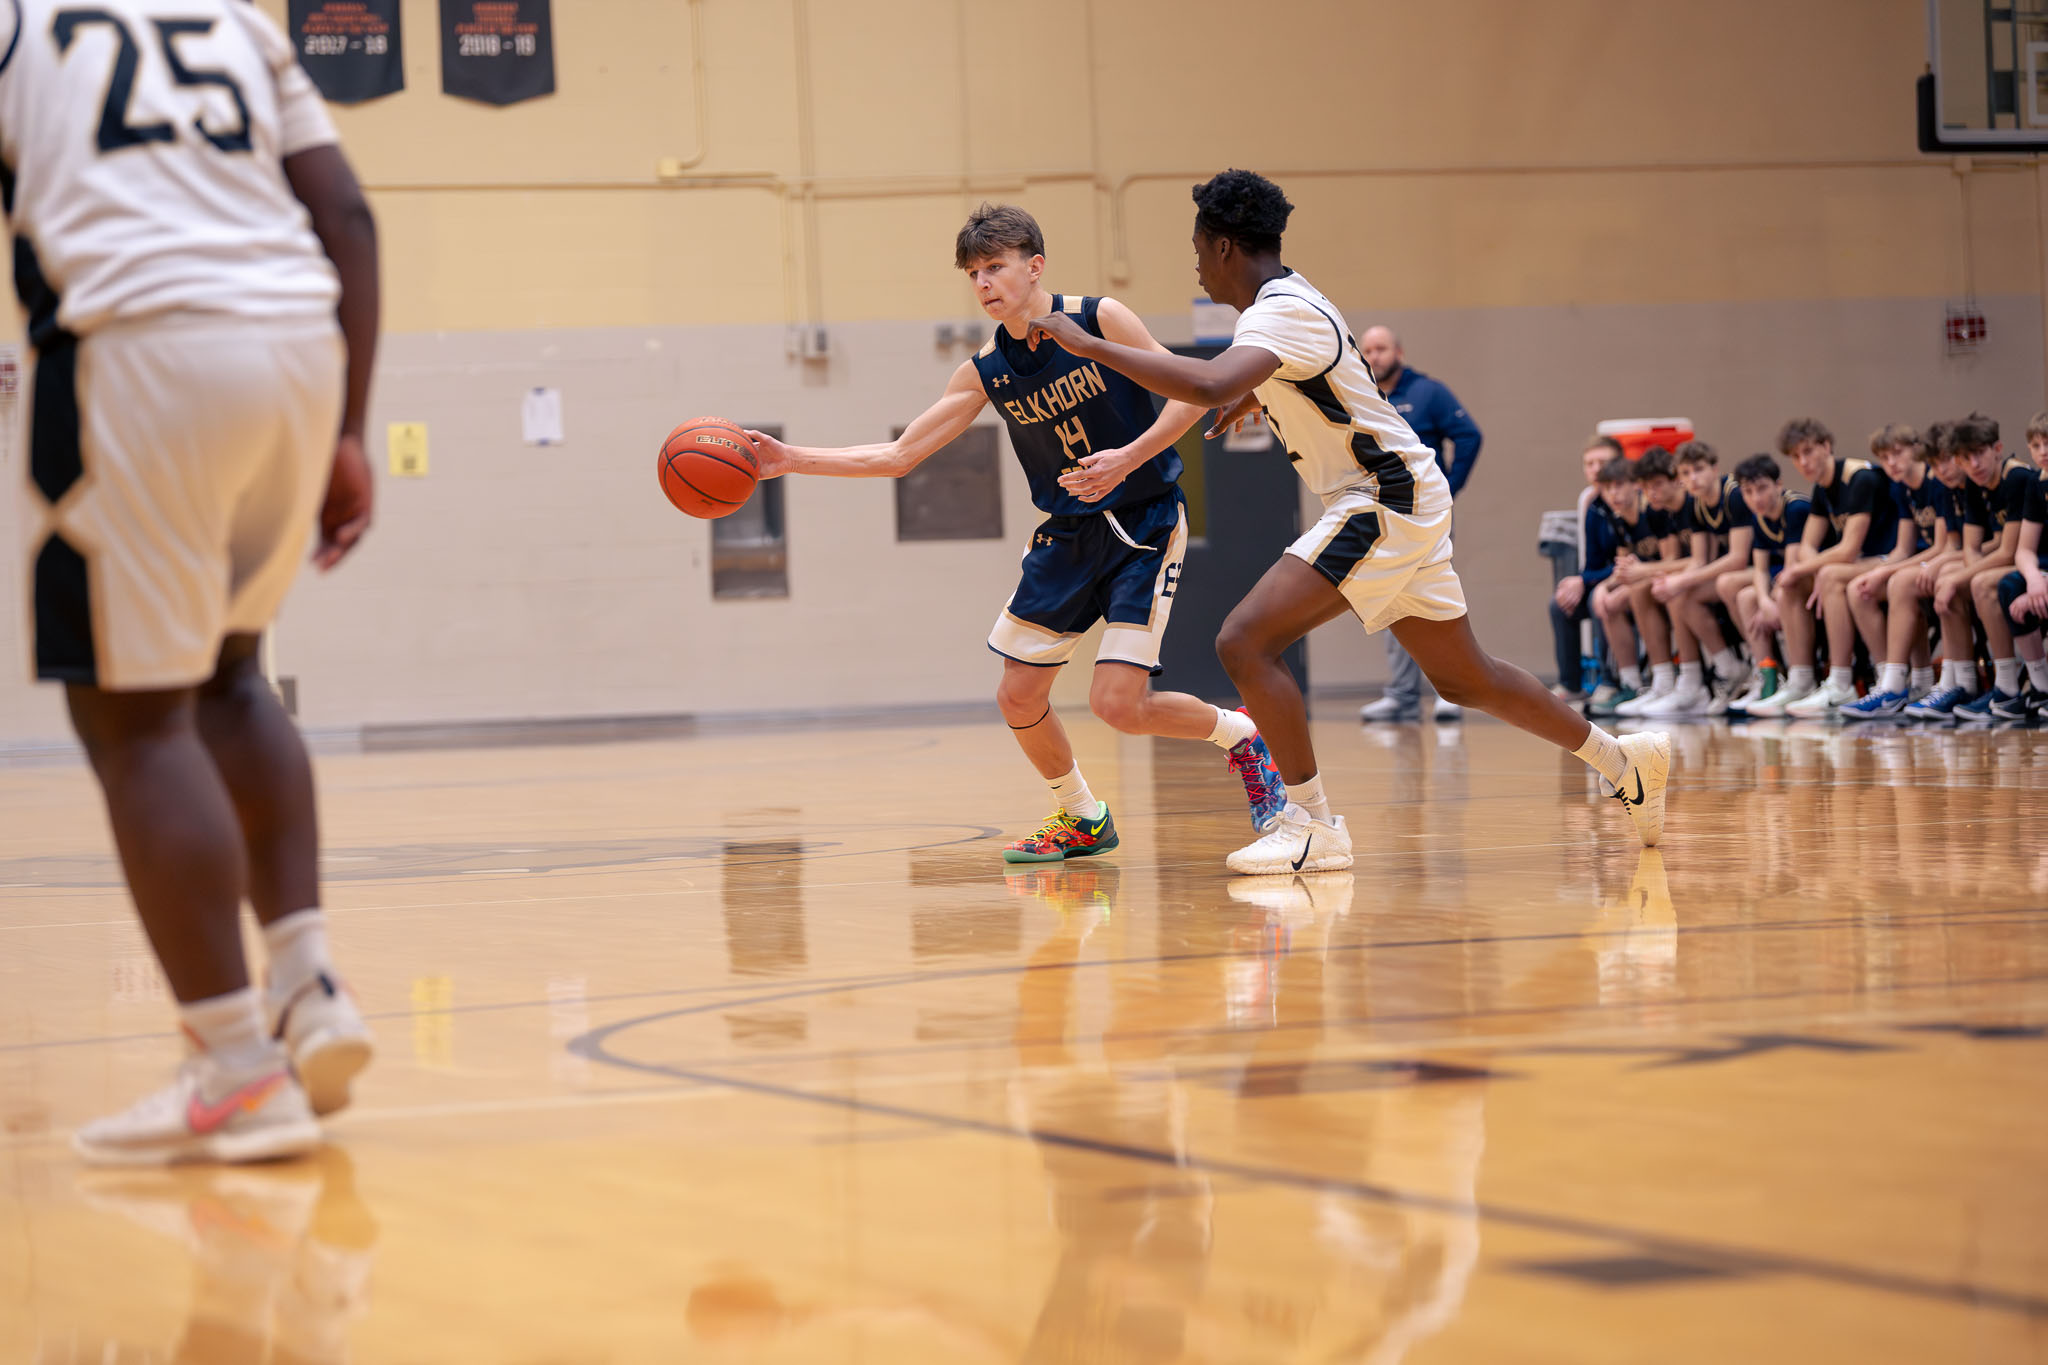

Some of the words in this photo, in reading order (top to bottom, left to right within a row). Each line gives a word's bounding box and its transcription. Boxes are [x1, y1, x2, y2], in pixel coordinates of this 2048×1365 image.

[51, 9, 254, 154] 25
[1004, 361, 1107, 425] ELKHORN
[1054, 415, 1091, 460] 14
